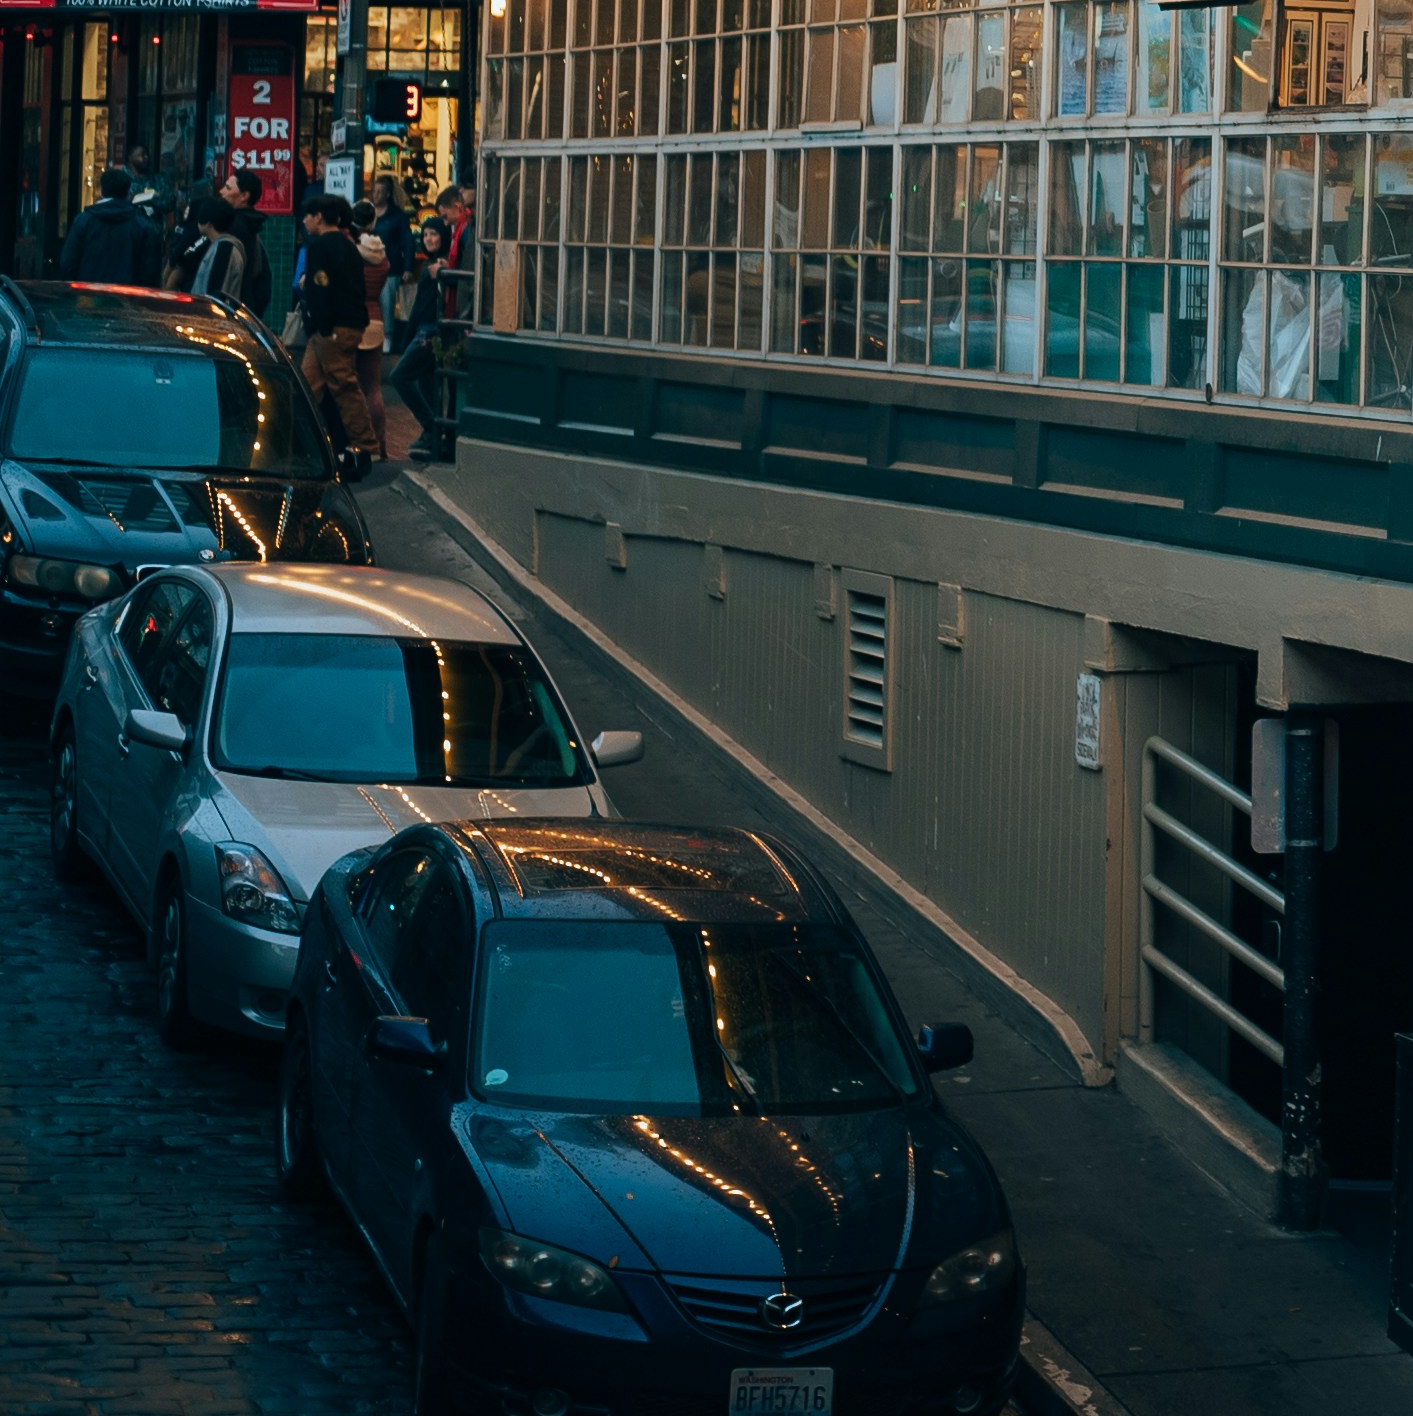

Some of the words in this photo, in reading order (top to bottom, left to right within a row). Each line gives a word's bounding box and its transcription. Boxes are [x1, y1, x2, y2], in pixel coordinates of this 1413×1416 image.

[252, 80, 271, 104] 2
[405, 85, 418, 117] 3
[234, 117, 289, 139] FOR
